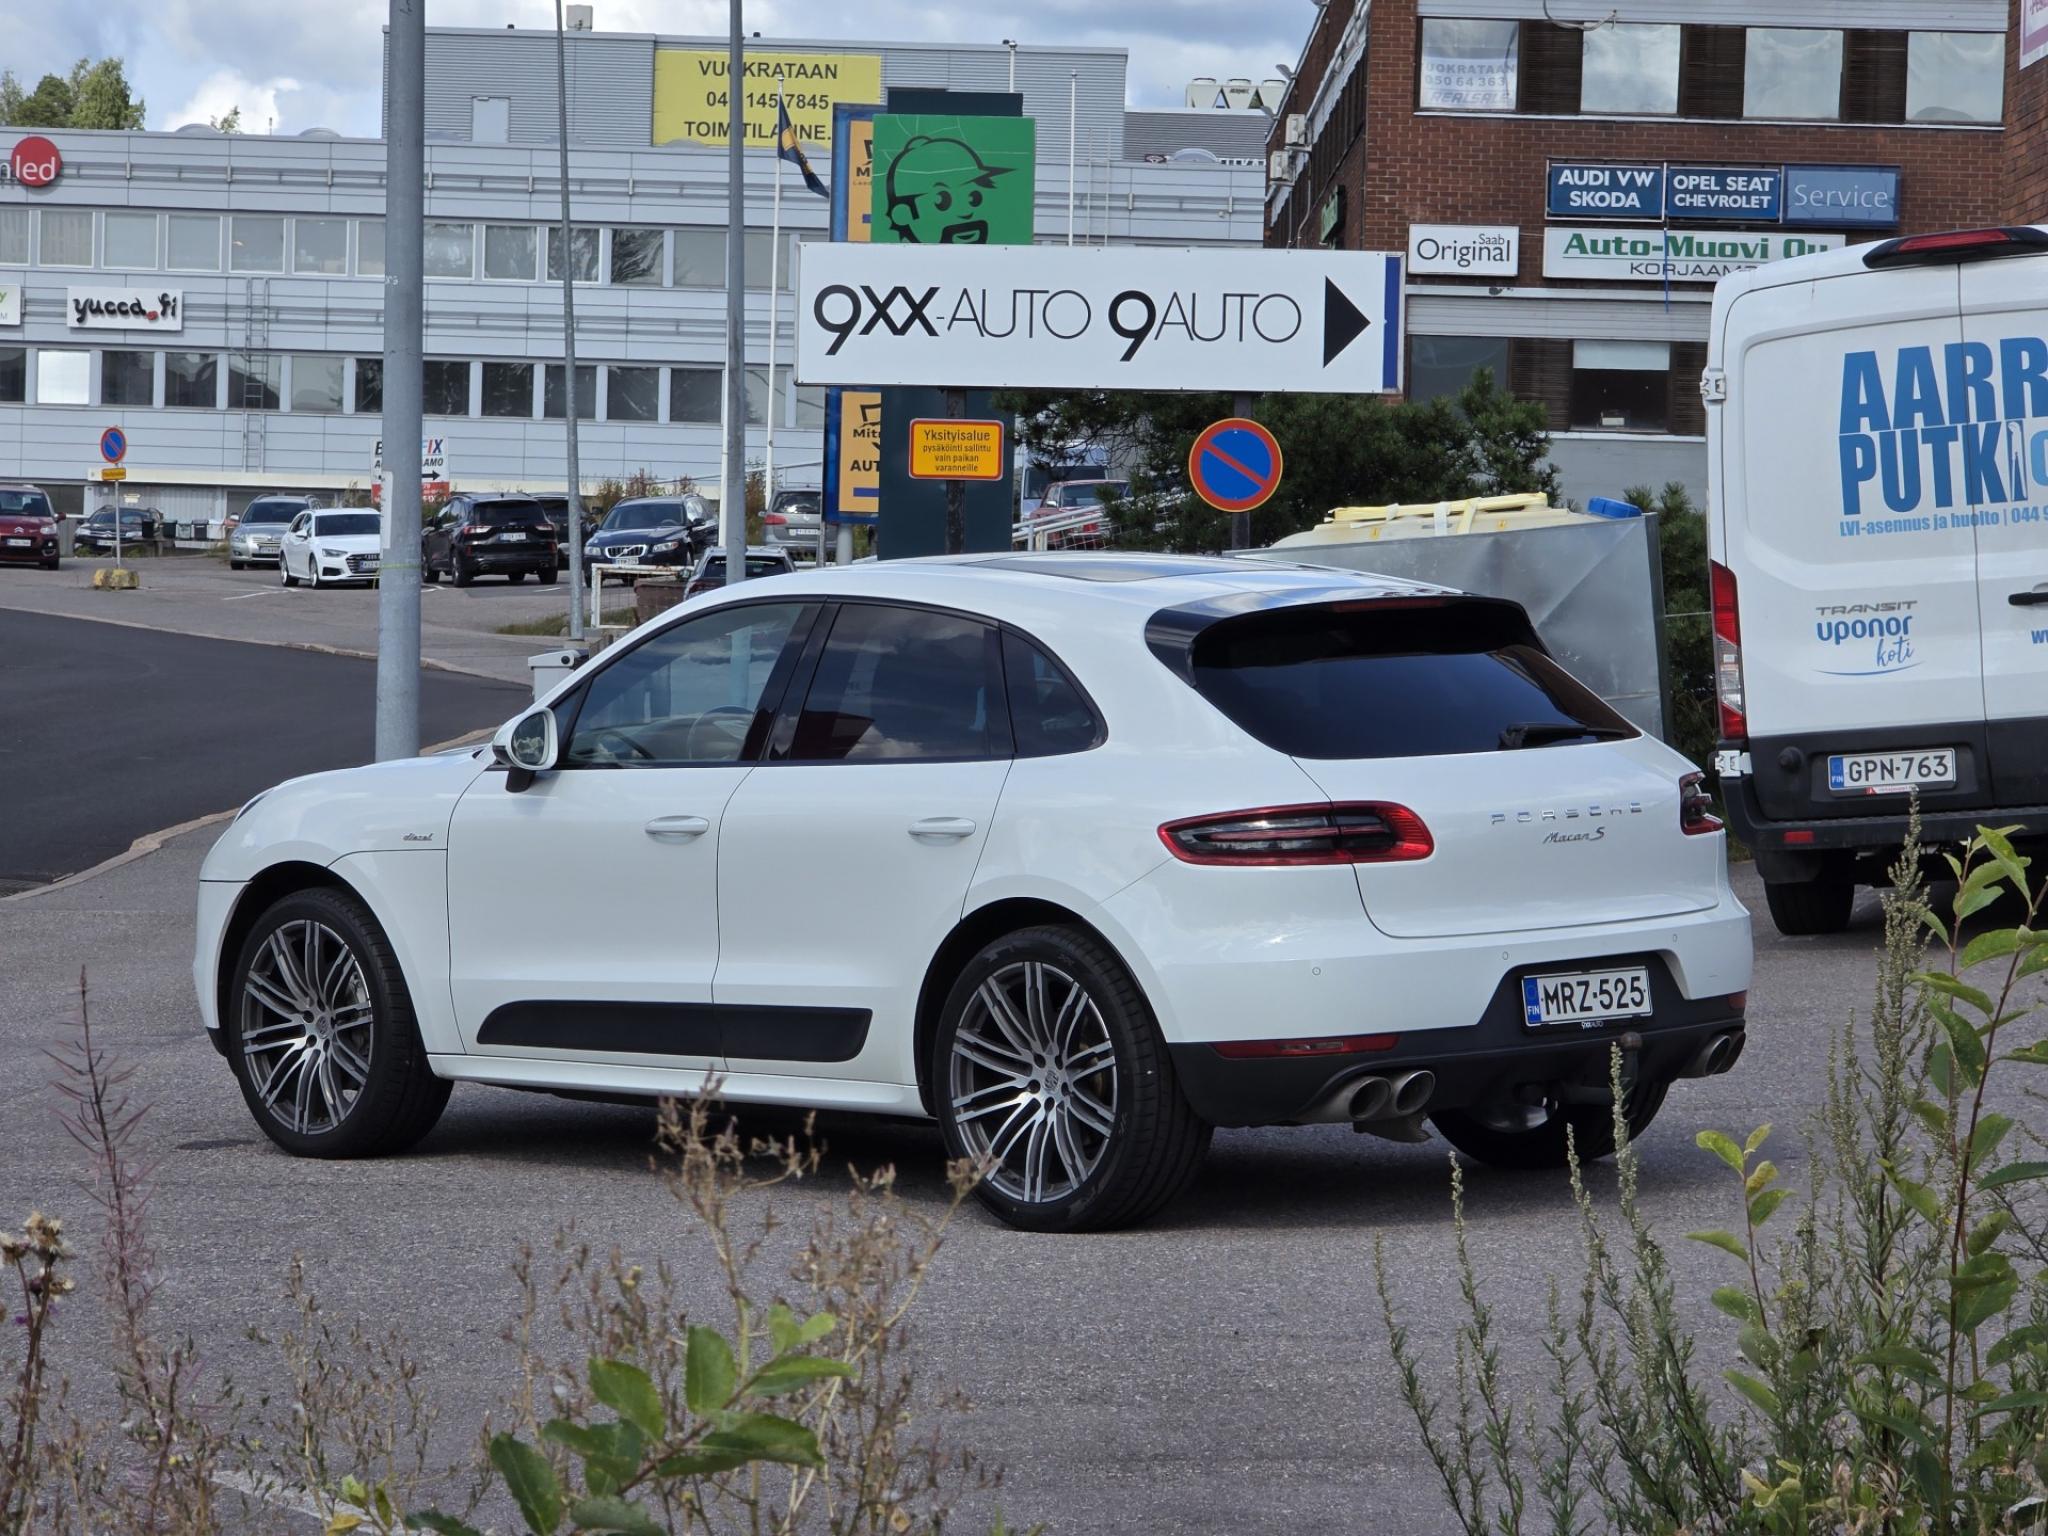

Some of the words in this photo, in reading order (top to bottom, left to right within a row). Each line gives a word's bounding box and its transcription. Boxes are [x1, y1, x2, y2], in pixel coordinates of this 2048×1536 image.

[746, 92, 778, 108] 145
[785, 94, 829, 109] 7845
[1558, 169, 1610, 186] AUDI
[1616, 171, 1655, 187] VW
[1673, 175, 1720, 191] OPEL
[1726, 177, 1774, 191] SEAT
[1569, 191, 1642, 208] SKODA
[1674, 194, 1772, 208] CHEVROLET
[1794, 184, 1888, 208] Service
[1479, 233, 1505, 245] Saab
[1563, 233, 1769, 258] Auto-Muovi
[1417, 238, 1511, 268] Original
[73, 292, 178, 323] yucca.fi
[813, 284, 1091, 356] 9XX-AUTO
[1107, 289, 1302, 362] 9AUTO
[852, 428, 880, 438] Mit
[924, 429, 991, 443] Yksityisalue
[964, 444, 991, 452] sallittu
[934, 454, 951, 462] vain
[953, 454, 979, 463] paikan
[1839, 515, 1931, 537] LVI-asennus
[1932, 513, 1948, 531] ja
[1950, 510, 2000, 528] huolto
[2010, 506, 2041, 524] 044
[1815, 600, 1918, 616] TRANSIT
[1816, 615, 1913, 645] uponor
[1876, 636, 1916, 667] koti
[1848, 754, 1950, 783] GPN-763
[1831, 774, 1845, 783] FIN
[1542, 831, 1590, 844] Macan
[1588, 826, 1606, 841] S
[1542, 976, 1645, 1016] MRZ-525
[1527, 1005, 1540, 1016] FIN
